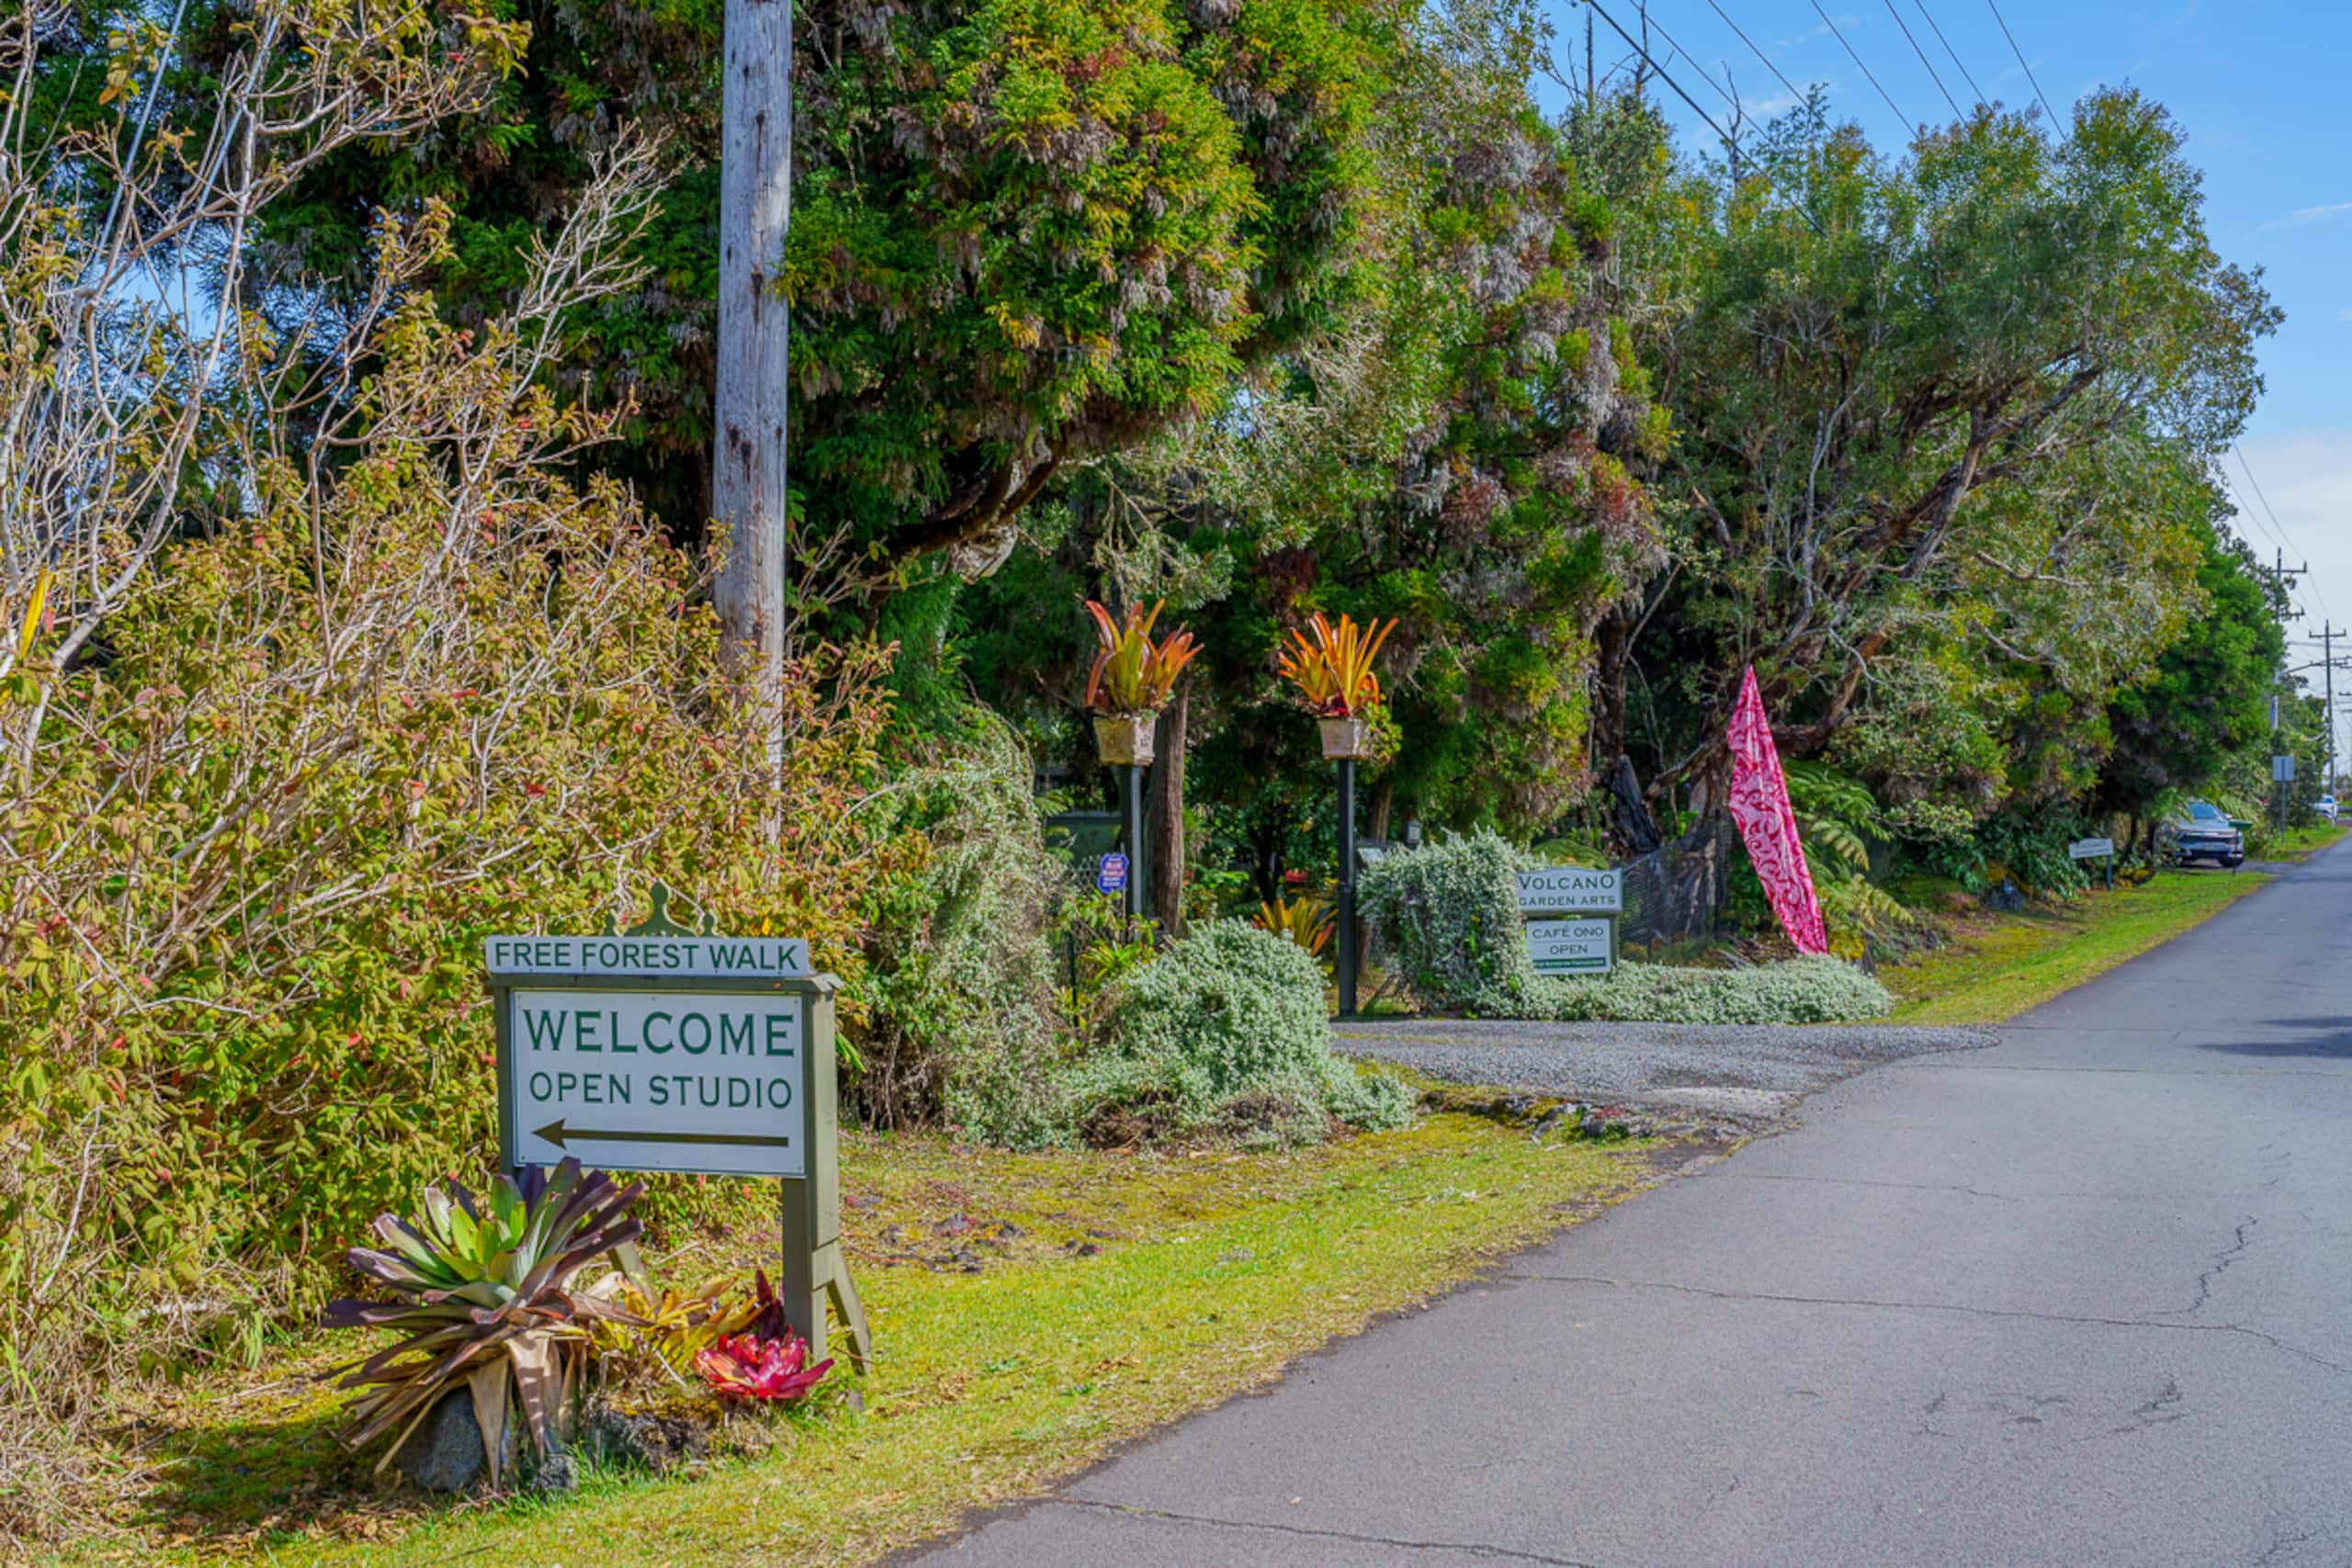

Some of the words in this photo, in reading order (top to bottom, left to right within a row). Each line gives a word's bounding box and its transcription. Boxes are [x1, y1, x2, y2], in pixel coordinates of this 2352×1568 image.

[1518, 874, 1614, 890] VOLCANO
[1519, 896, 1575, 906] GARDEN
[1580, 896, 1616, 906] ARTS
[1574, 927, 1604, 937] ONO
[495, 942, 571, 966] FREE
[582, 942, 699, 969] FOREST
[709, 944, 798, 970] WALK
[1550, 944, 1589, 955] OPEN
[523, 1010, 796, 1057] WELCOME
[529, 1071, 632, 1104] OPEN
[649, 1076, 793, 1110] STUDIO
